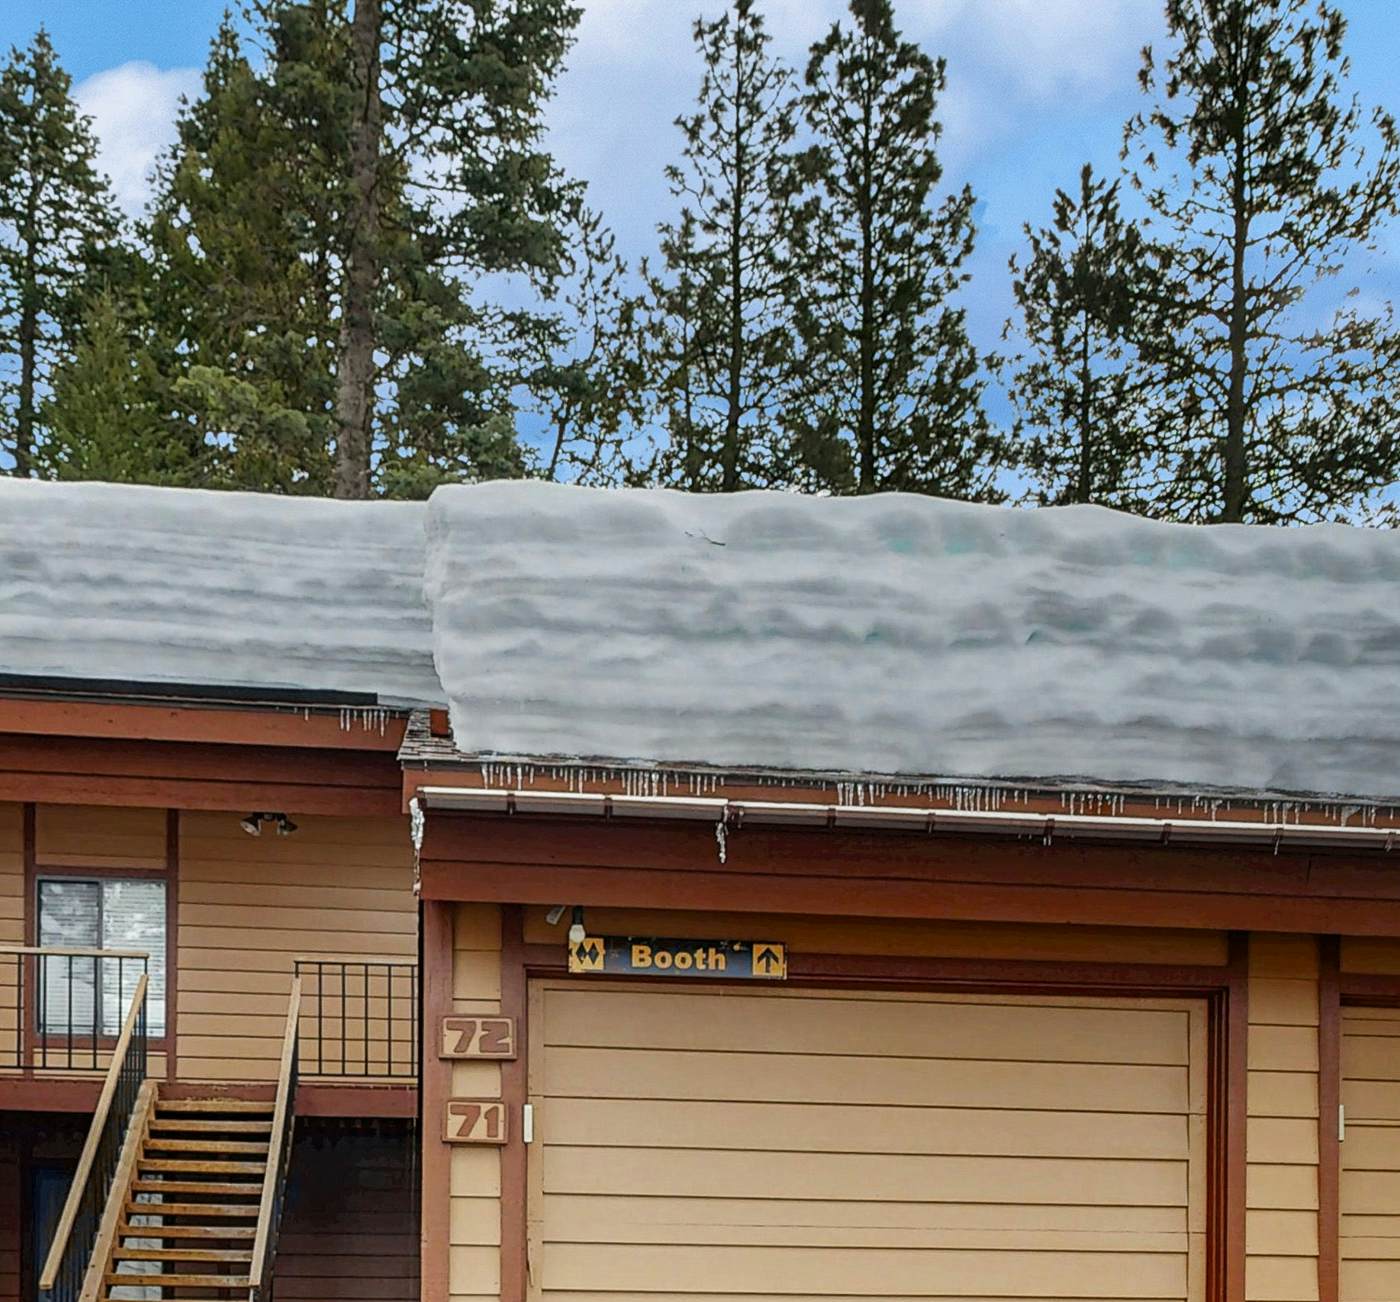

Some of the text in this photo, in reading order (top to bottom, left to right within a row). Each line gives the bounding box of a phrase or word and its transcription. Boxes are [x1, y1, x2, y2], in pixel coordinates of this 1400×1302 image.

[631, 943, 727, 971] Booth
[446, 1020, 510, 1053] 72
[450, 1104, 499, 1138] 71
